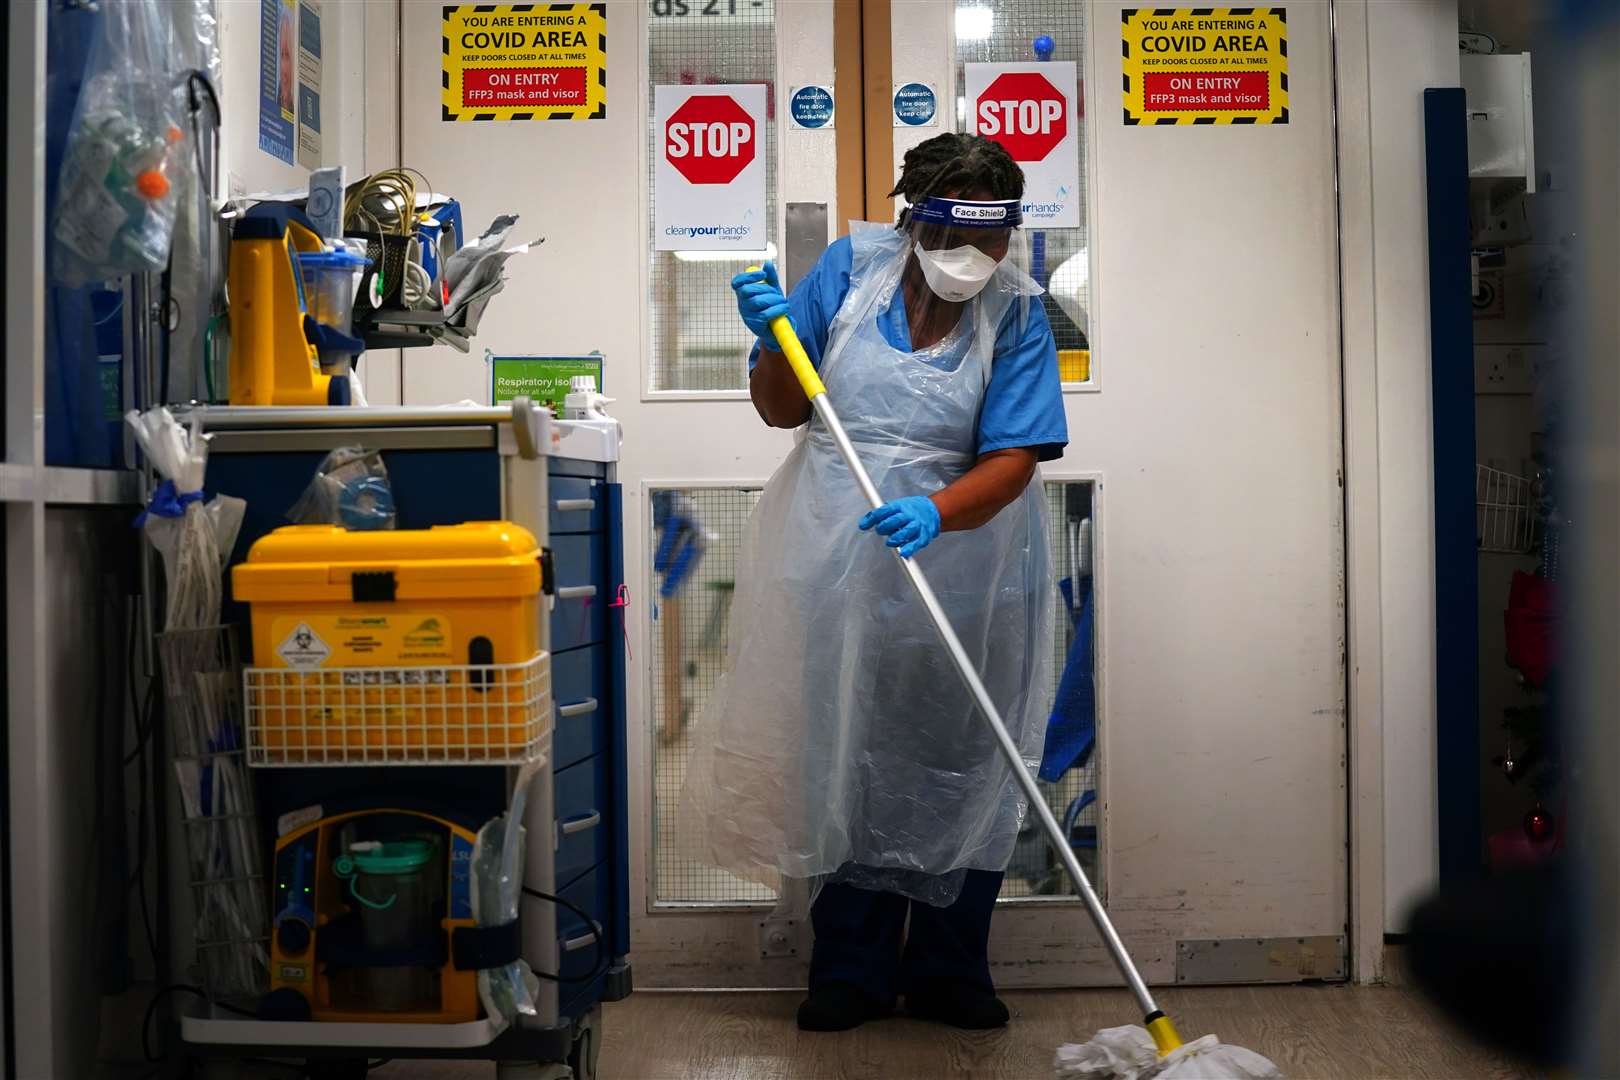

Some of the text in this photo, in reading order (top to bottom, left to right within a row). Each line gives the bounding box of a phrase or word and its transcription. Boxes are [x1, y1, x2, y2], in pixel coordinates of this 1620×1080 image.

[463, 16, 587, 27] YOU ARE ENTERING A
[1142, 20, 1267, 31] YOU ARE ENTERING A
[461, 31, 587, 49] COVID AREA
[1141, 35, 1269, 53] COVID AREA
[488, 73, 559, 86] ON ENTRY
[1170, 78, 1241, 90] ON ENTRY
[469, 89, 579, 100] FFP3 mask and visor
[1150, 93, 1262, 104] FFP3 mask and visor
[978, 100, 1062, 135] STOP
[668, 122, 751, 158] STOP
[955, 208, 976, 217] Face
[979, 209, 1004, 217] Shield
[497, 377, 552, 388] Respiratory
[520, 387, 530, 395] for
